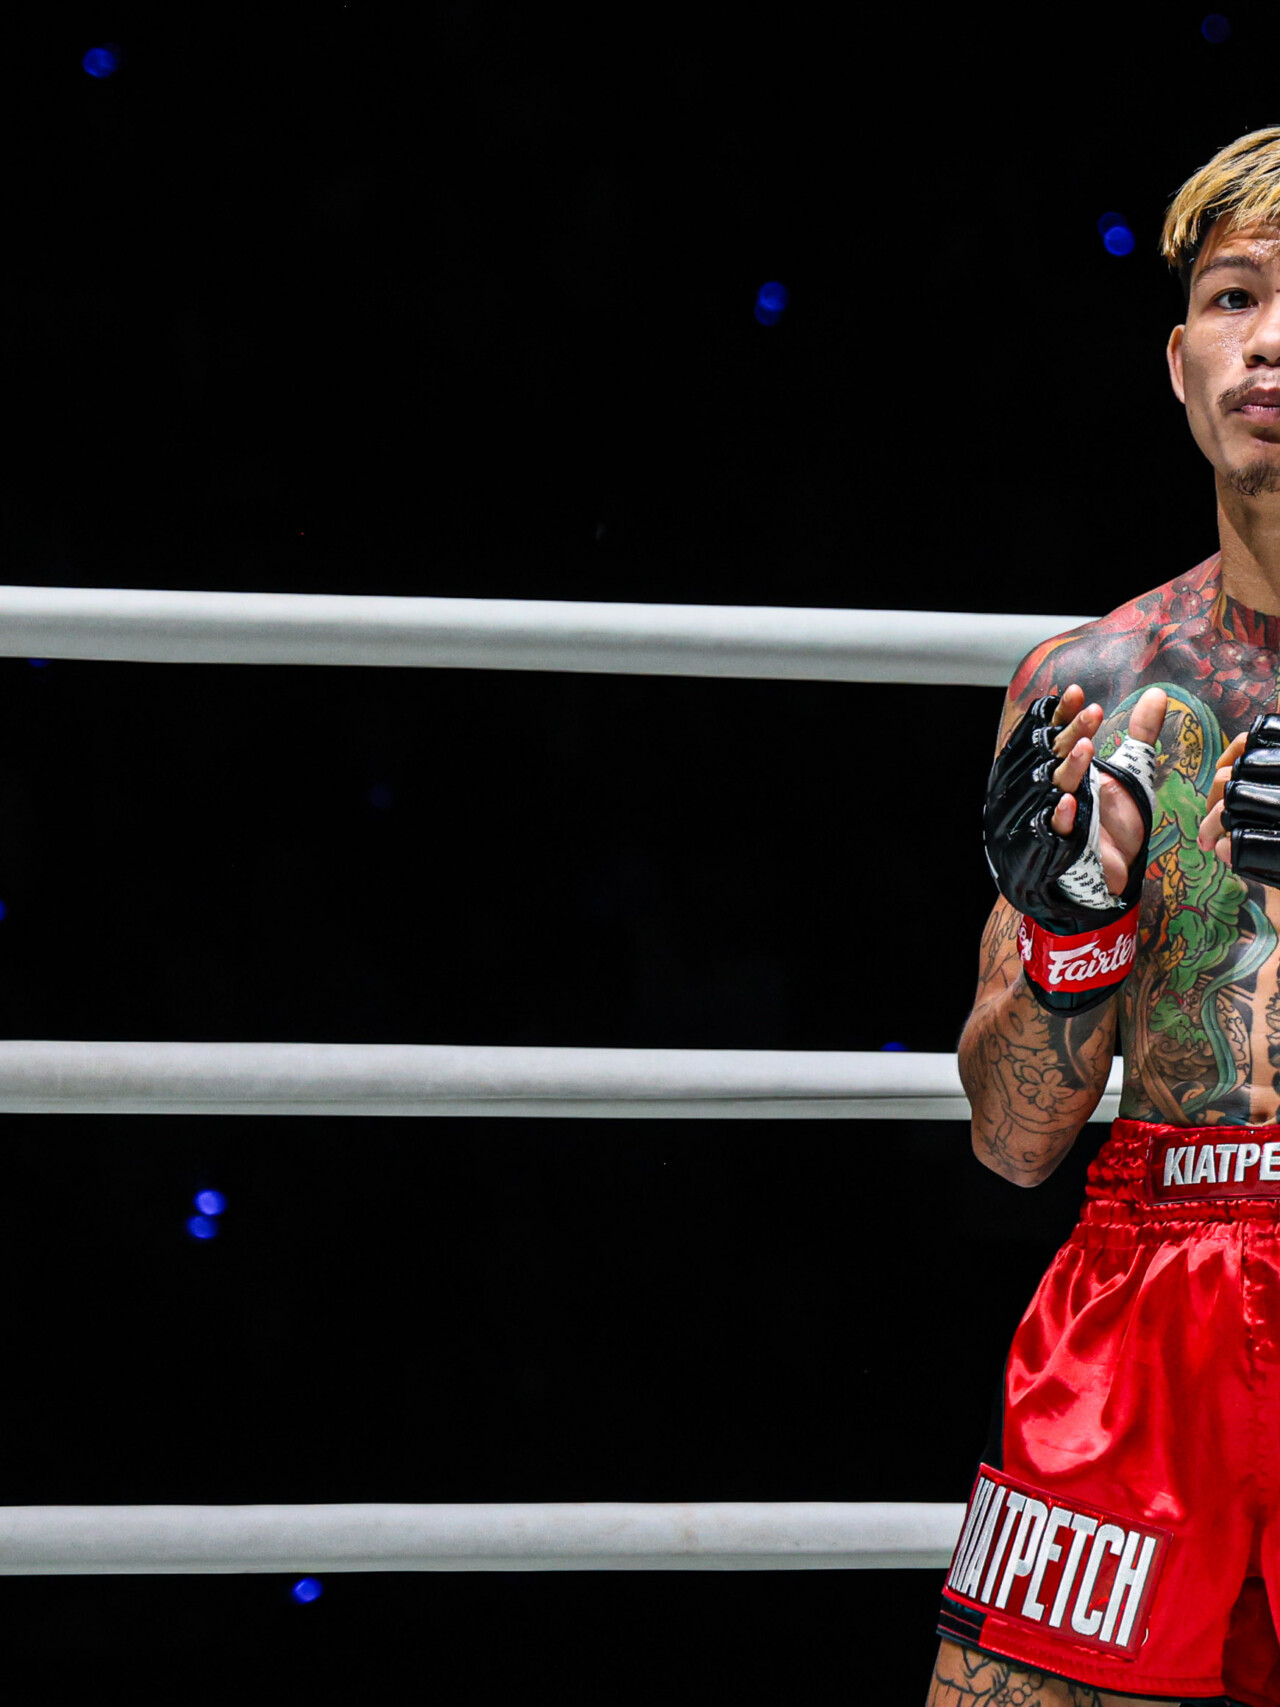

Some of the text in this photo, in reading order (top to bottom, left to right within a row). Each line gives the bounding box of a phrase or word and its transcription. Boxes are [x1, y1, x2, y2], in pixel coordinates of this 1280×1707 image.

[1125, 763, 1141, 775] ONE
[1073, 872, 1088, 882] ONE
[1079, 878, 1094, 887] ONE
[948, 1476, 1158, 1647] KIATPETCH
